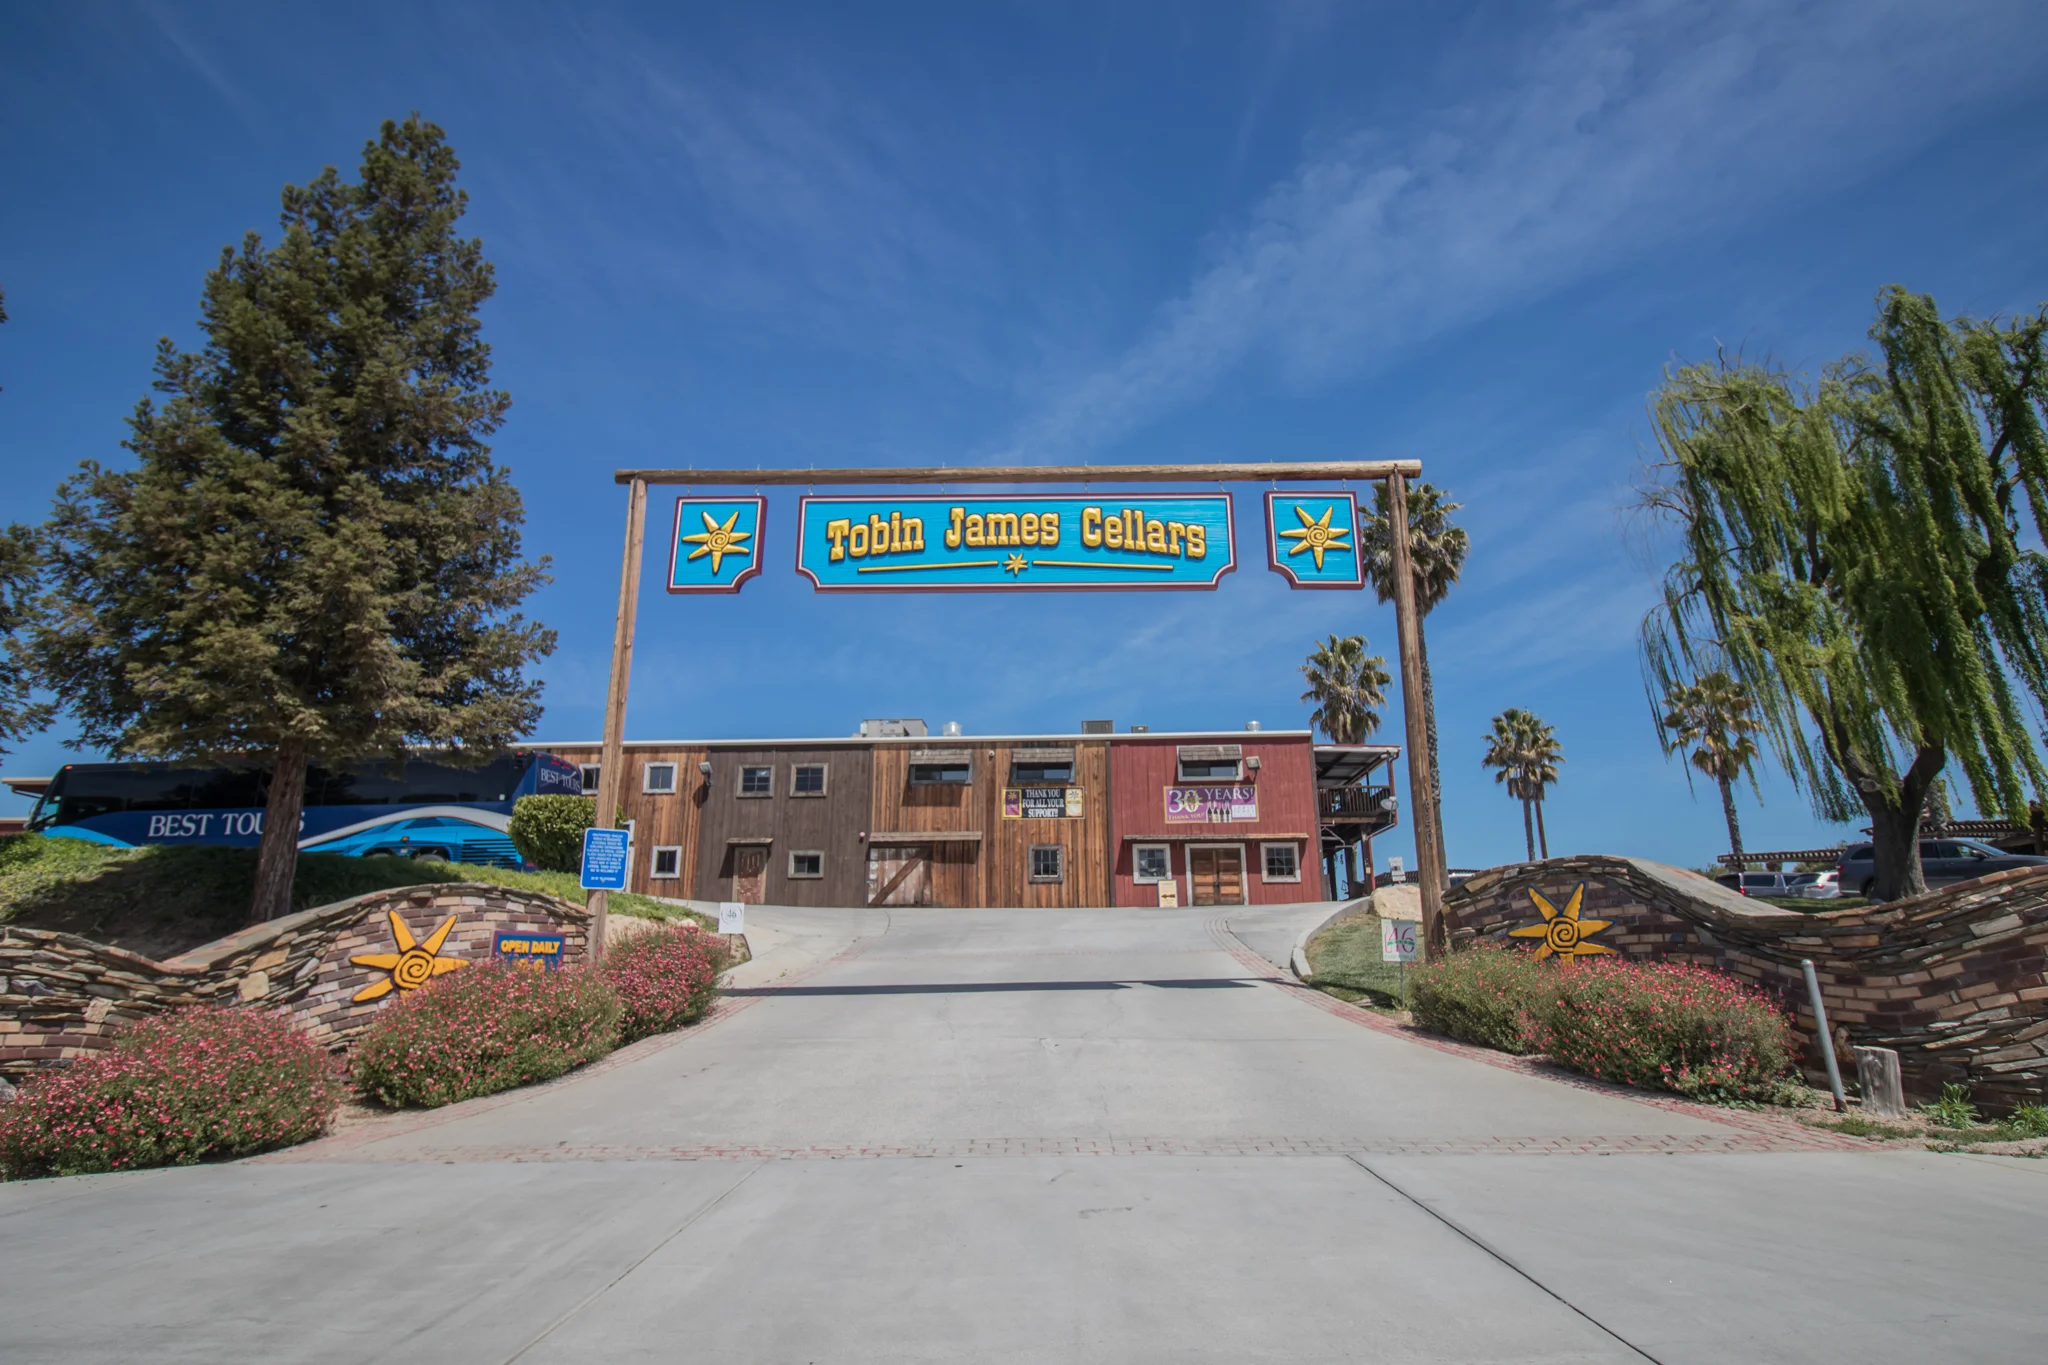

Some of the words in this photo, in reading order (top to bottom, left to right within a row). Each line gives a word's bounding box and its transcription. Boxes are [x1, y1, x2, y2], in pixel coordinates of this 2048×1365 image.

[827, 512, 925, 562] Tobin
[945, 507, 1061, 549] James
[1081, 506, 1207, 559] Cellars
[541, 768, 560, 784] BEST
[1025, 789, 1048, 798] THANK
[1048, 789, 1061, 798] YOU
[1168, 789, 1200, 813] 30
[1204, 788, 1254, 801] YEARS!
[1022, 799, 1036, 808] FOR
[1035, 799, 1048, 808] ALL
[1047, 799, 1065, 808] YOUR
[148, 814, 214, 837] BEST
[500, 940, 530, 953] OPEN
[531, 941, 560, 954] DAILY
